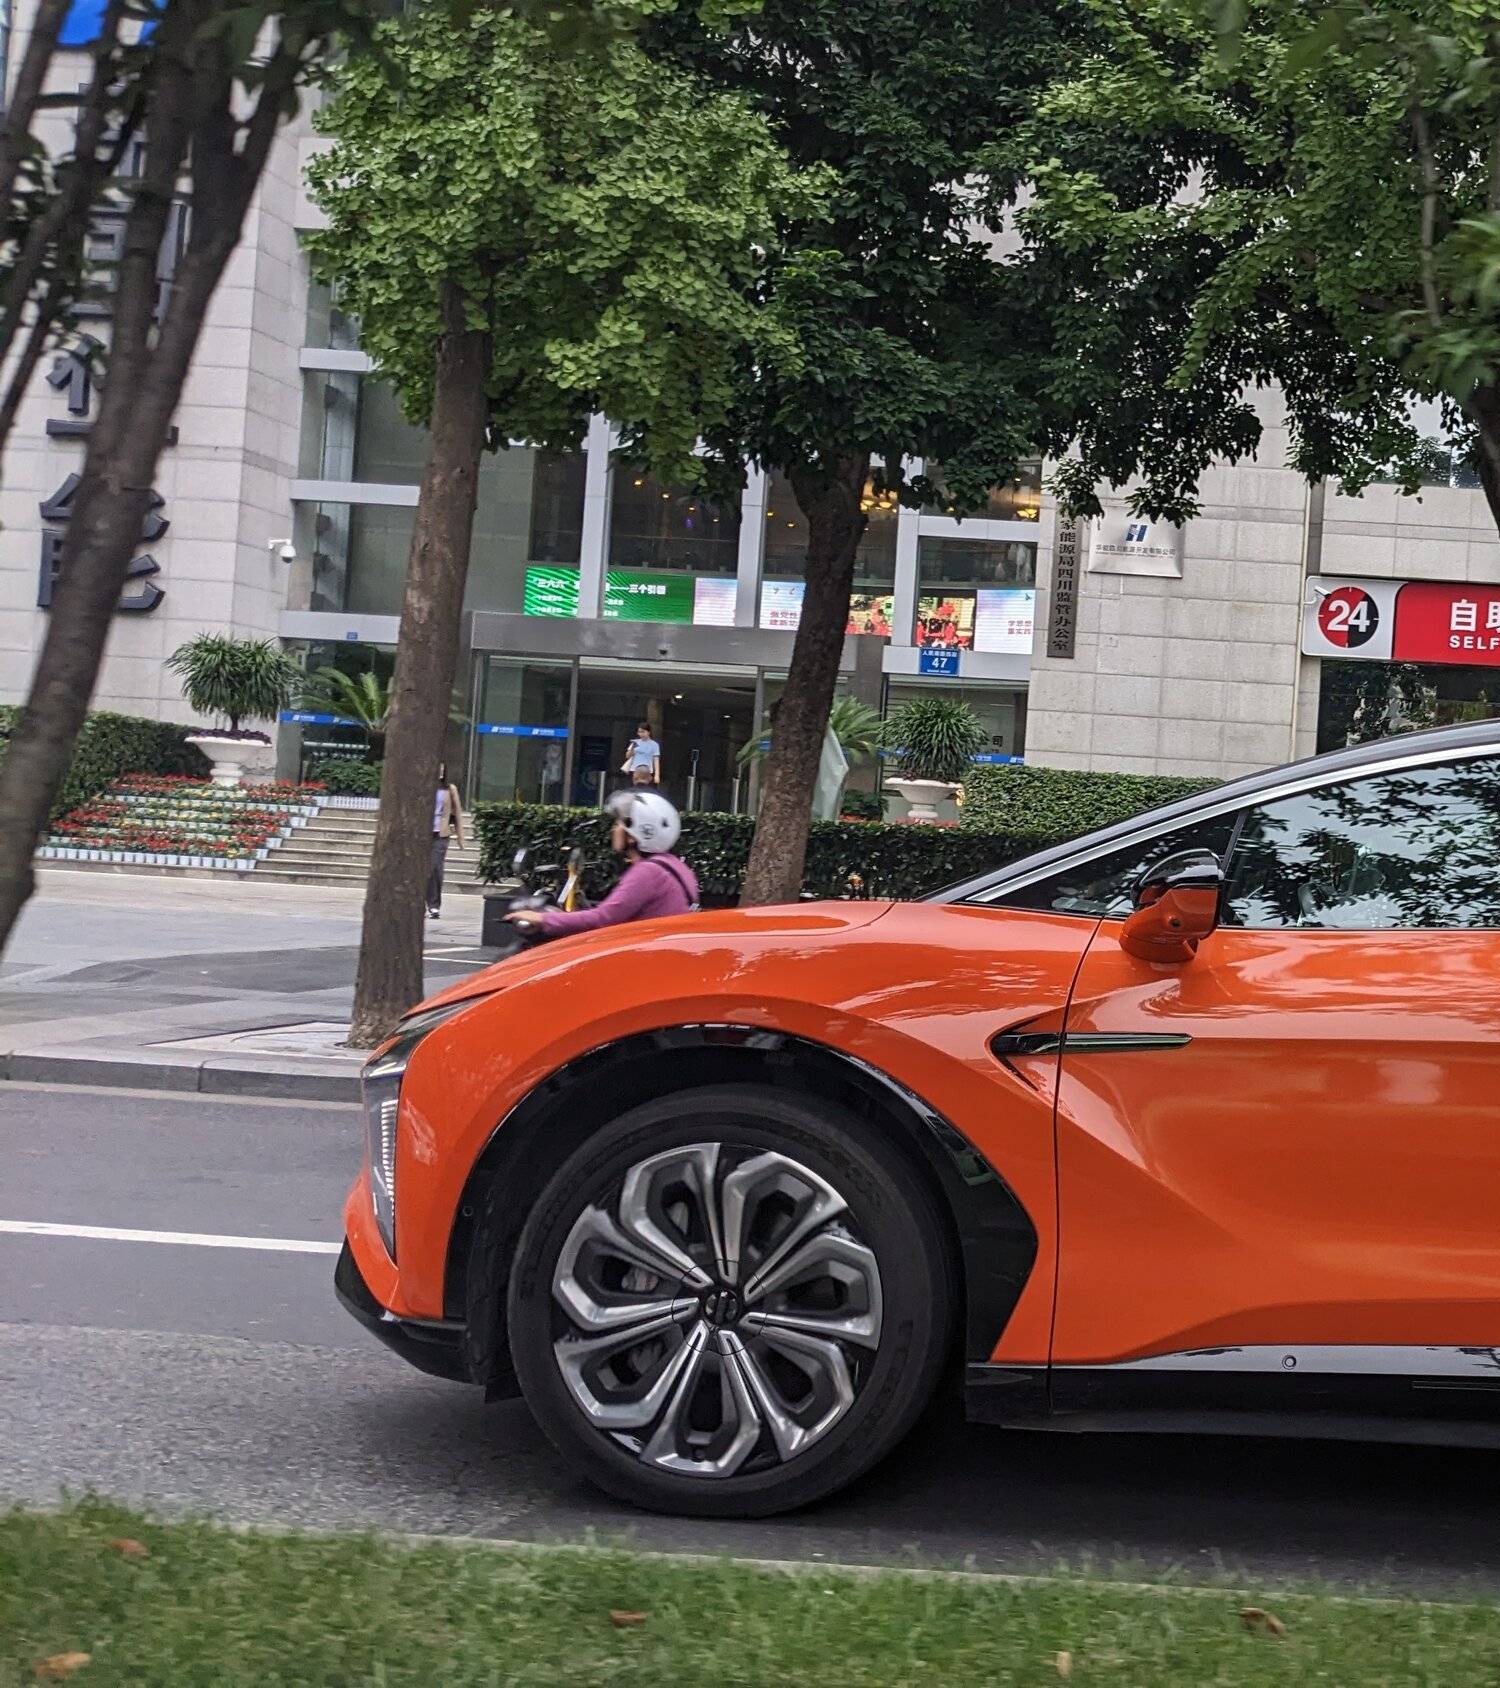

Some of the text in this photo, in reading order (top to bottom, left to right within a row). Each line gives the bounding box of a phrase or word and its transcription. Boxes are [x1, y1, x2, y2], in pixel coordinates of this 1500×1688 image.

[1052, 509, 1077, 650] 家能源局四川监管办公室
[1327, 599, 1370, 633] 24
[931, 657, 948, 668] 47
